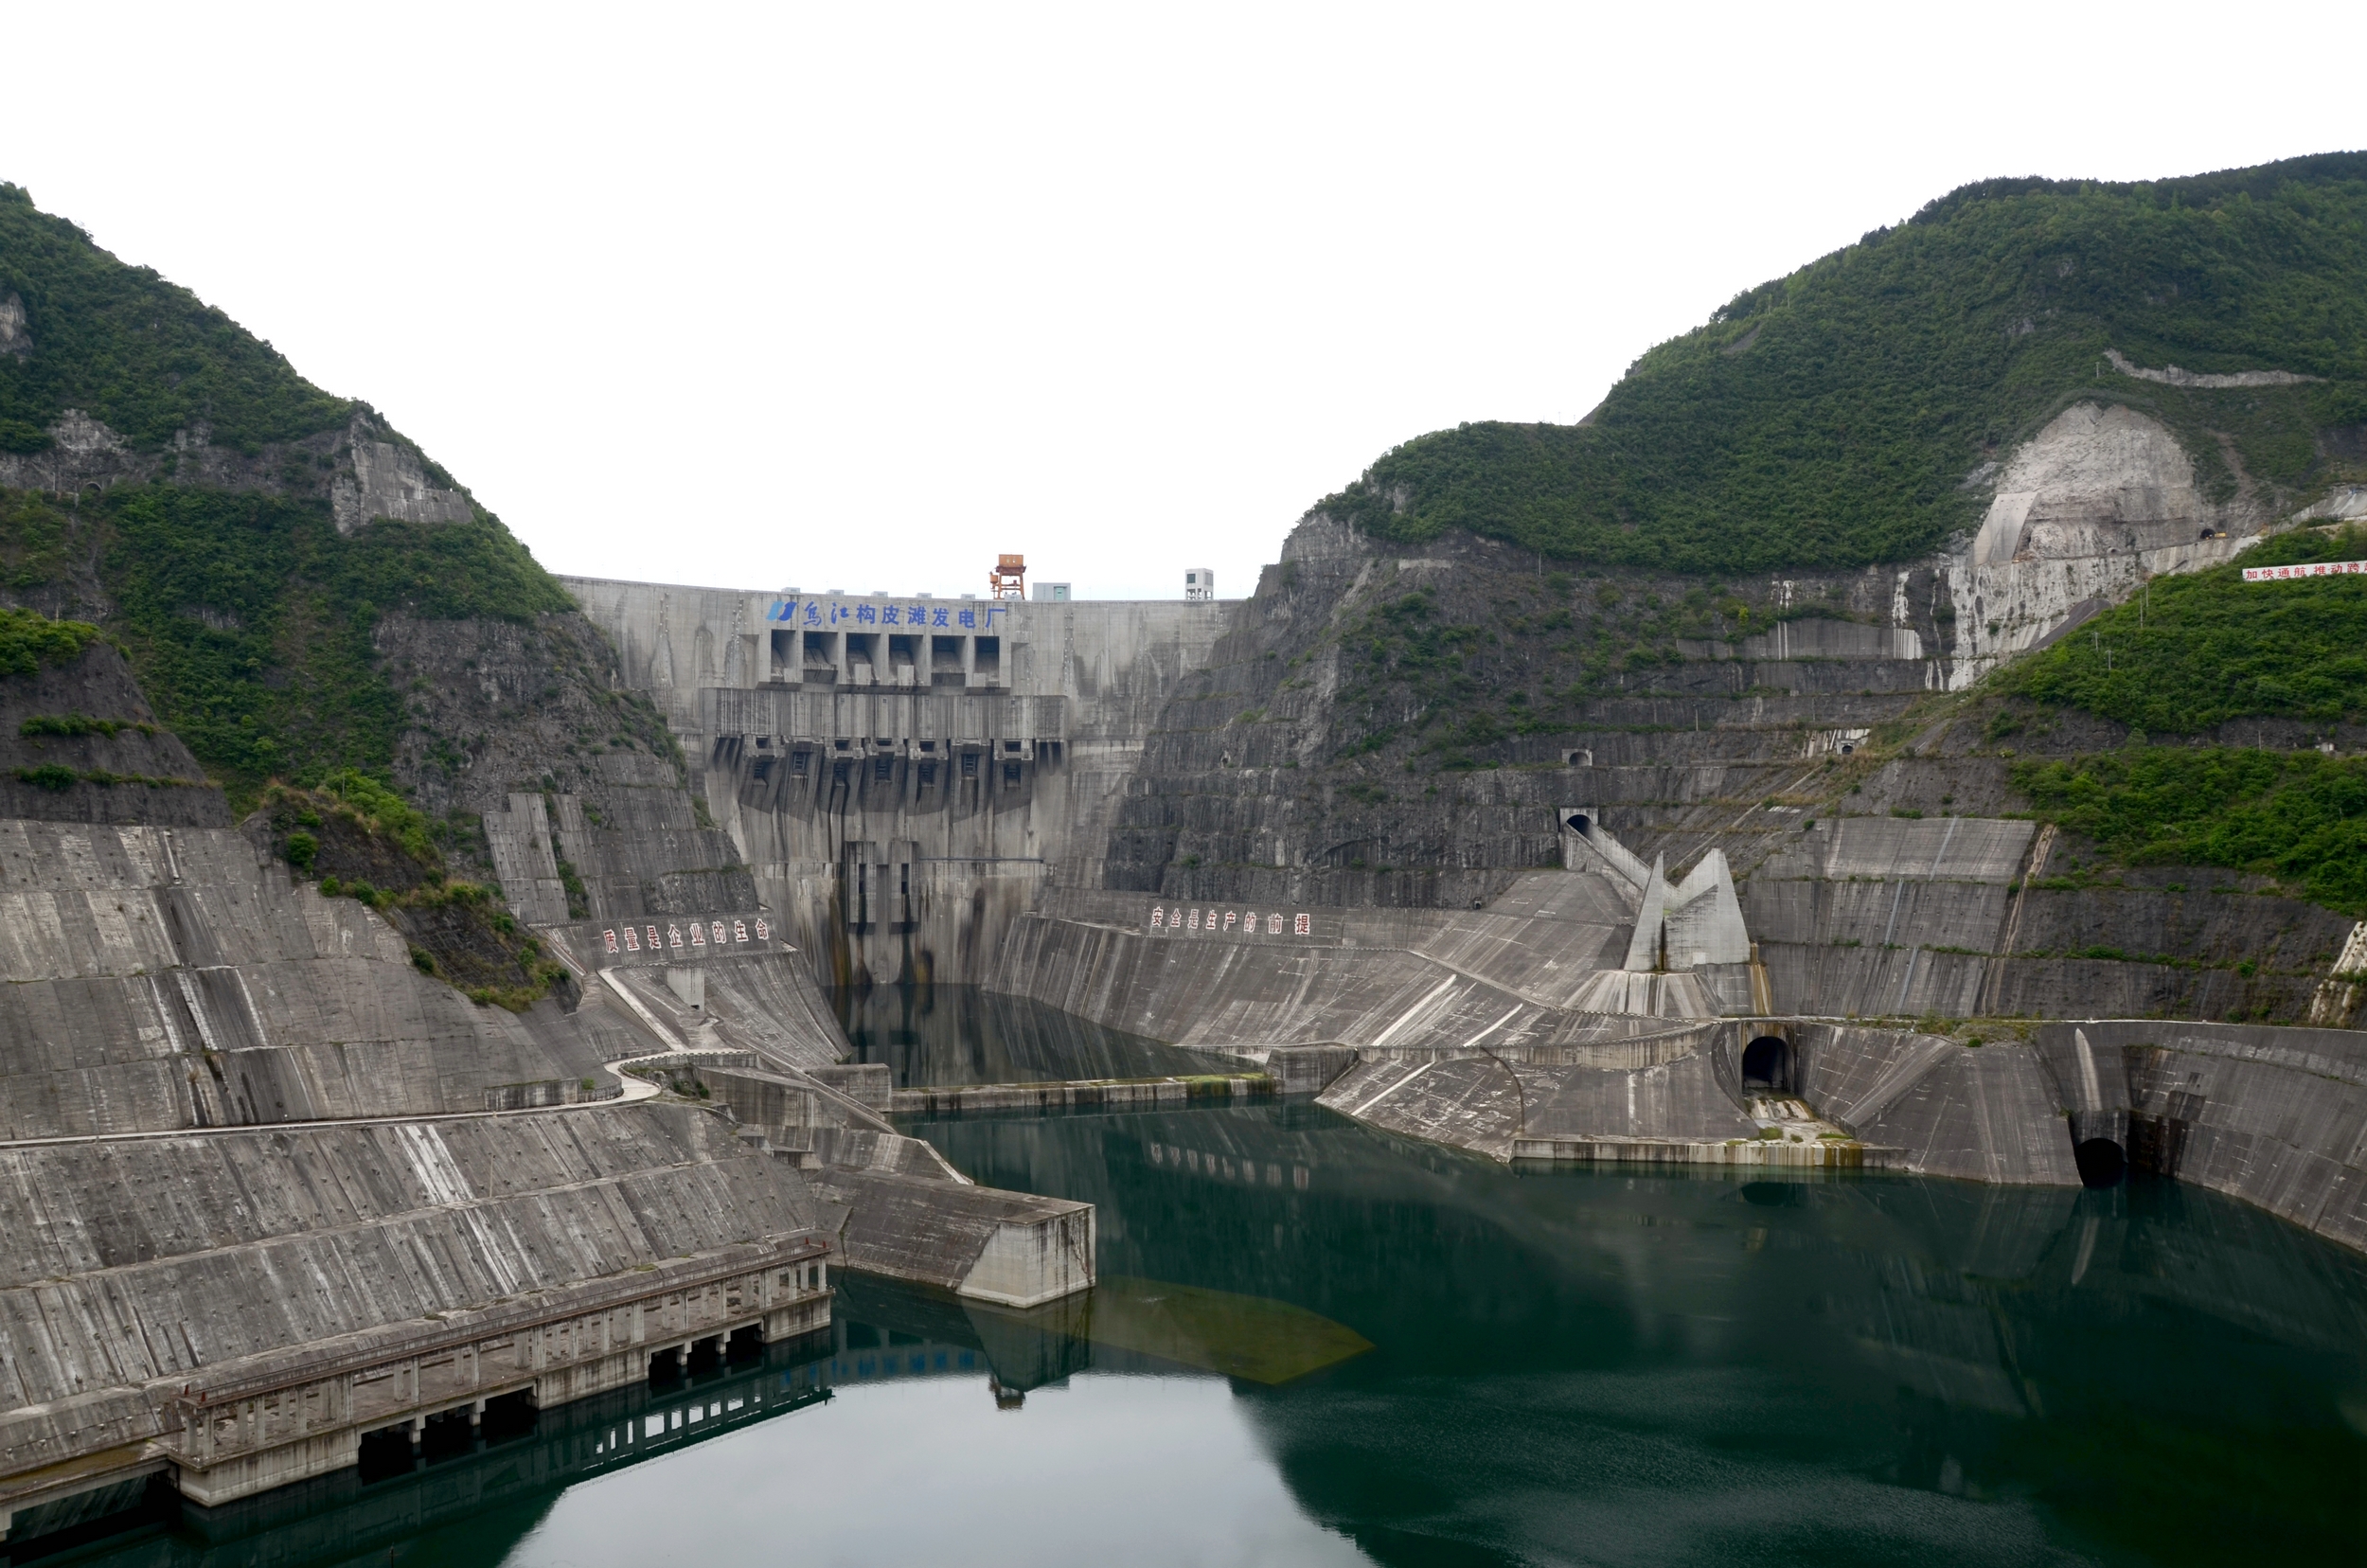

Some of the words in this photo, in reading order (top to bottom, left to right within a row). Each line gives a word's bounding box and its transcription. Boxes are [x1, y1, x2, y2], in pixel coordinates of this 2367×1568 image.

[2313, 562, 2367, 575] 推动跨
[1151, 906, 1310, 935] 安全是生产的前提
[603, 918, 769, 953] 质量是企业的生命
